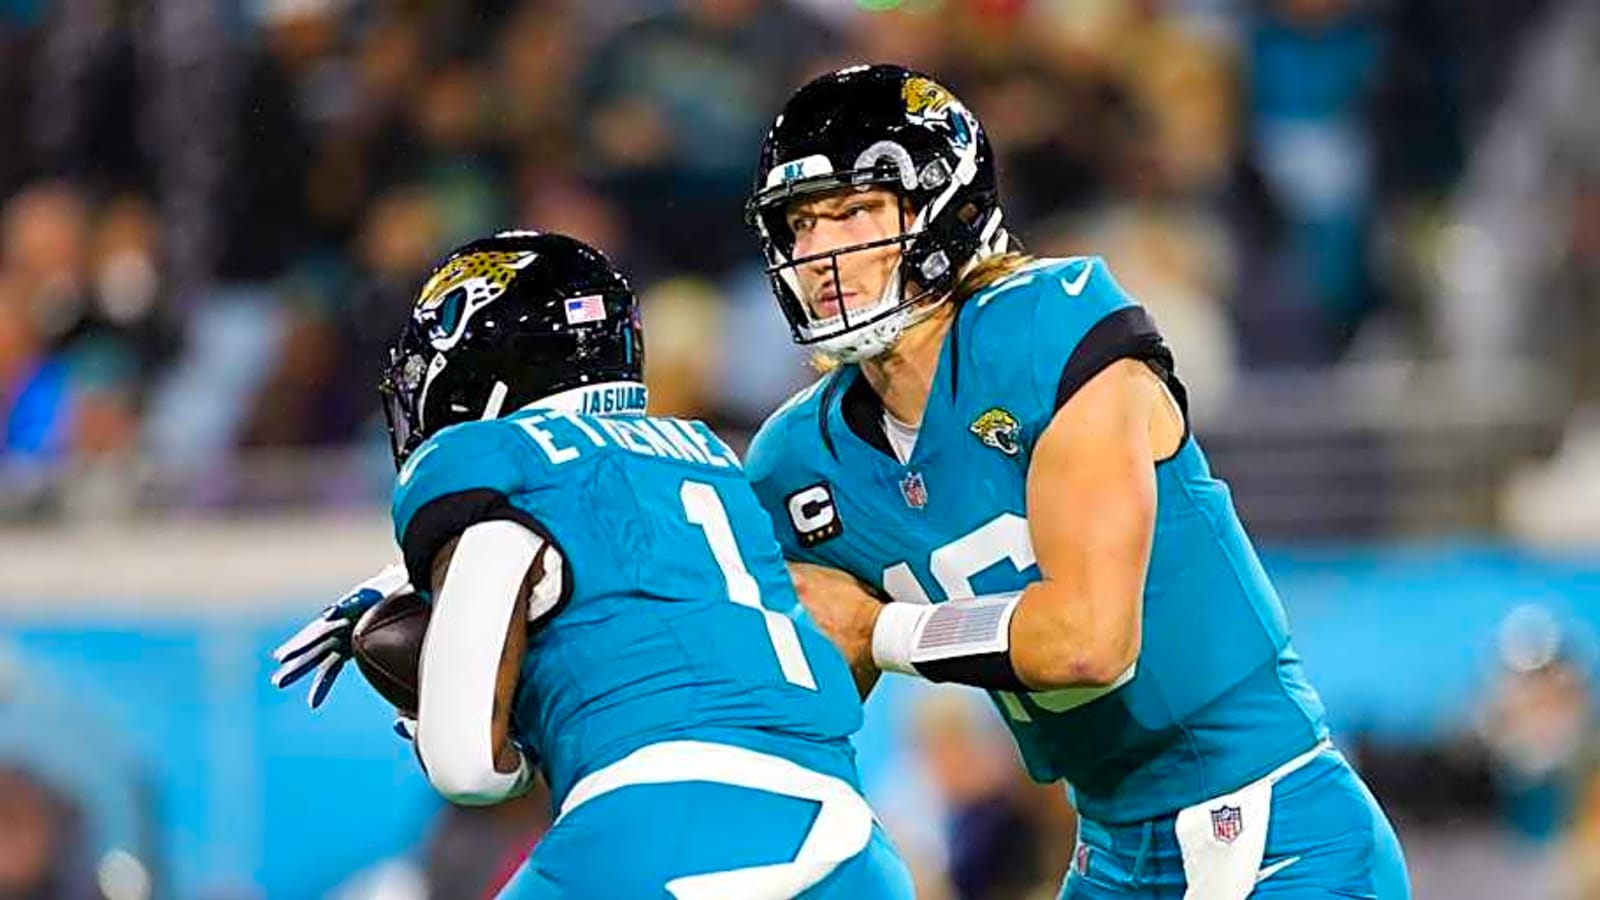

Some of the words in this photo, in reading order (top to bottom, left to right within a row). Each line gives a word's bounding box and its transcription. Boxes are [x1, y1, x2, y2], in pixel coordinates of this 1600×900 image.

[515, 410, 730, 465] ETIENNE
[788, 486, 835, 534] C
[680, 480, 818, 690] 1
